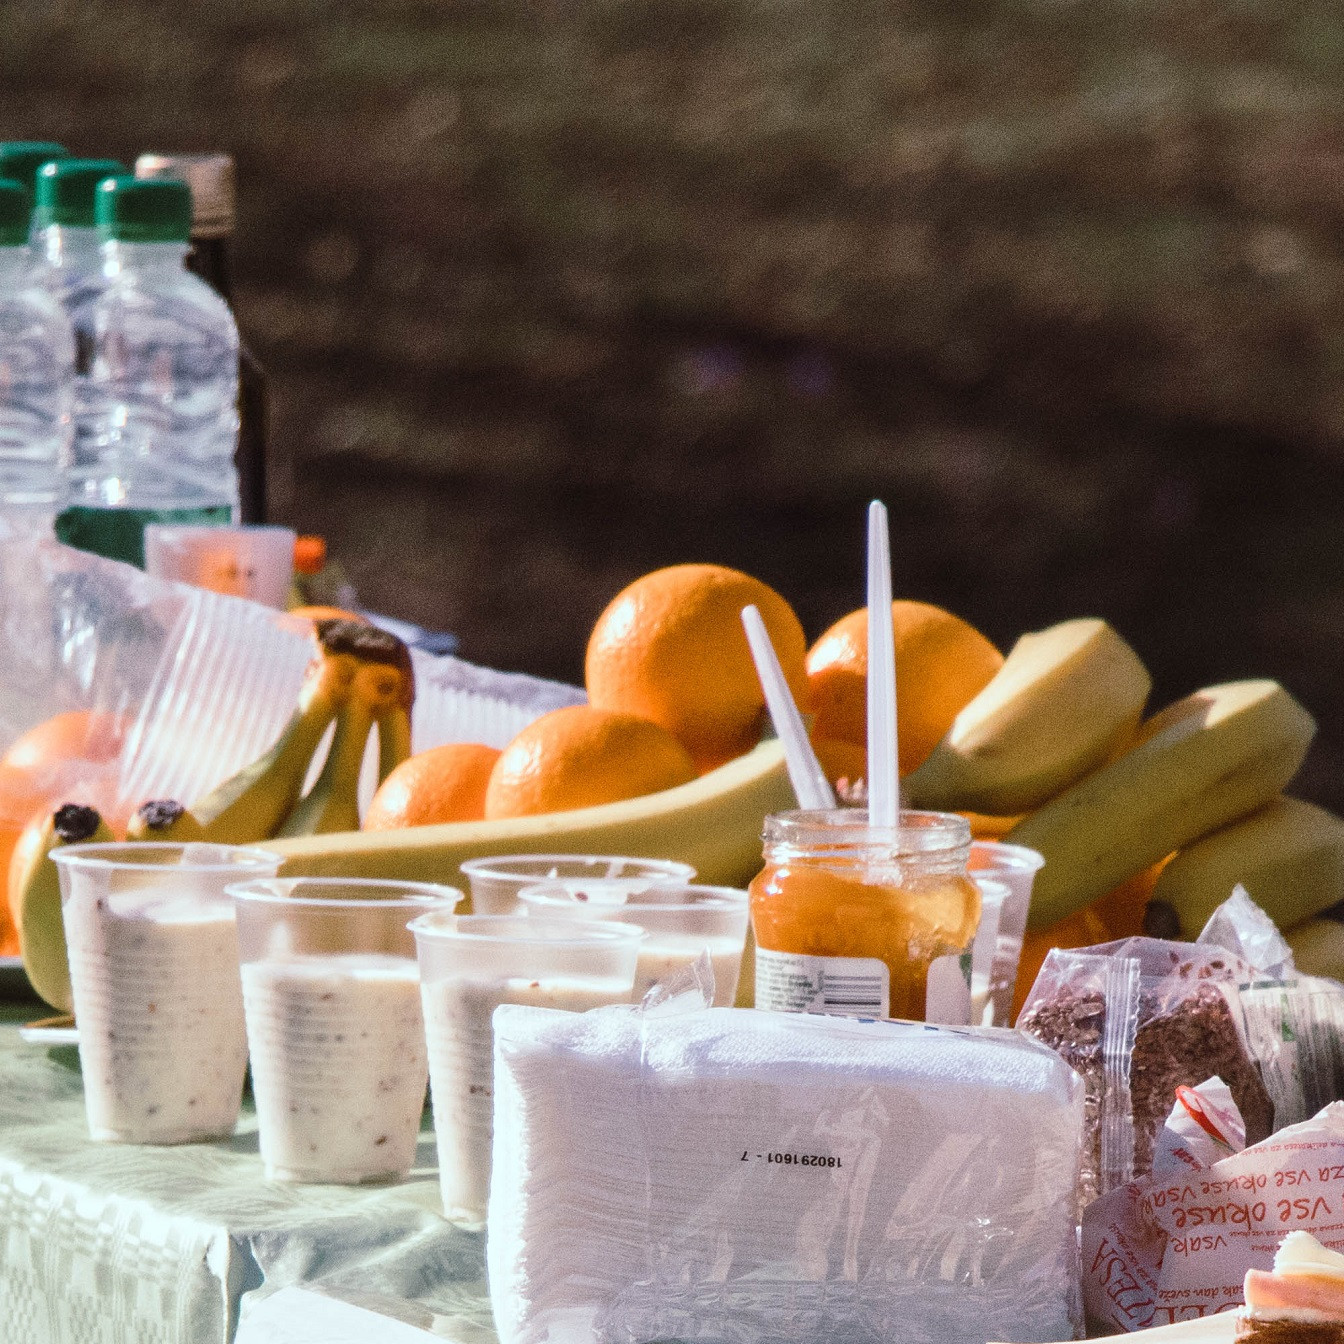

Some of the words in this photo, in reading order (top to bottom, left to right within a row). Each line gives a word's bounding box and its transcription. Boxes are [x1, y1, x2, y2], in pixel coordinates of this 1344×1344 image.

[740, 1151, 749, 1162] 7
[767, 1152, 843, 1168] 180291601
[1200, 1175, 1268, 1195] okuse
[1274, 1168, 1311, 1188] vse
[1171, 1201, 1267, 1232] okuse
[1276, 1194, 1332, 1225] vse
[1170, 1232, 1228, 1258] vsak
[1222, 1284, 1244, 1298] sak
